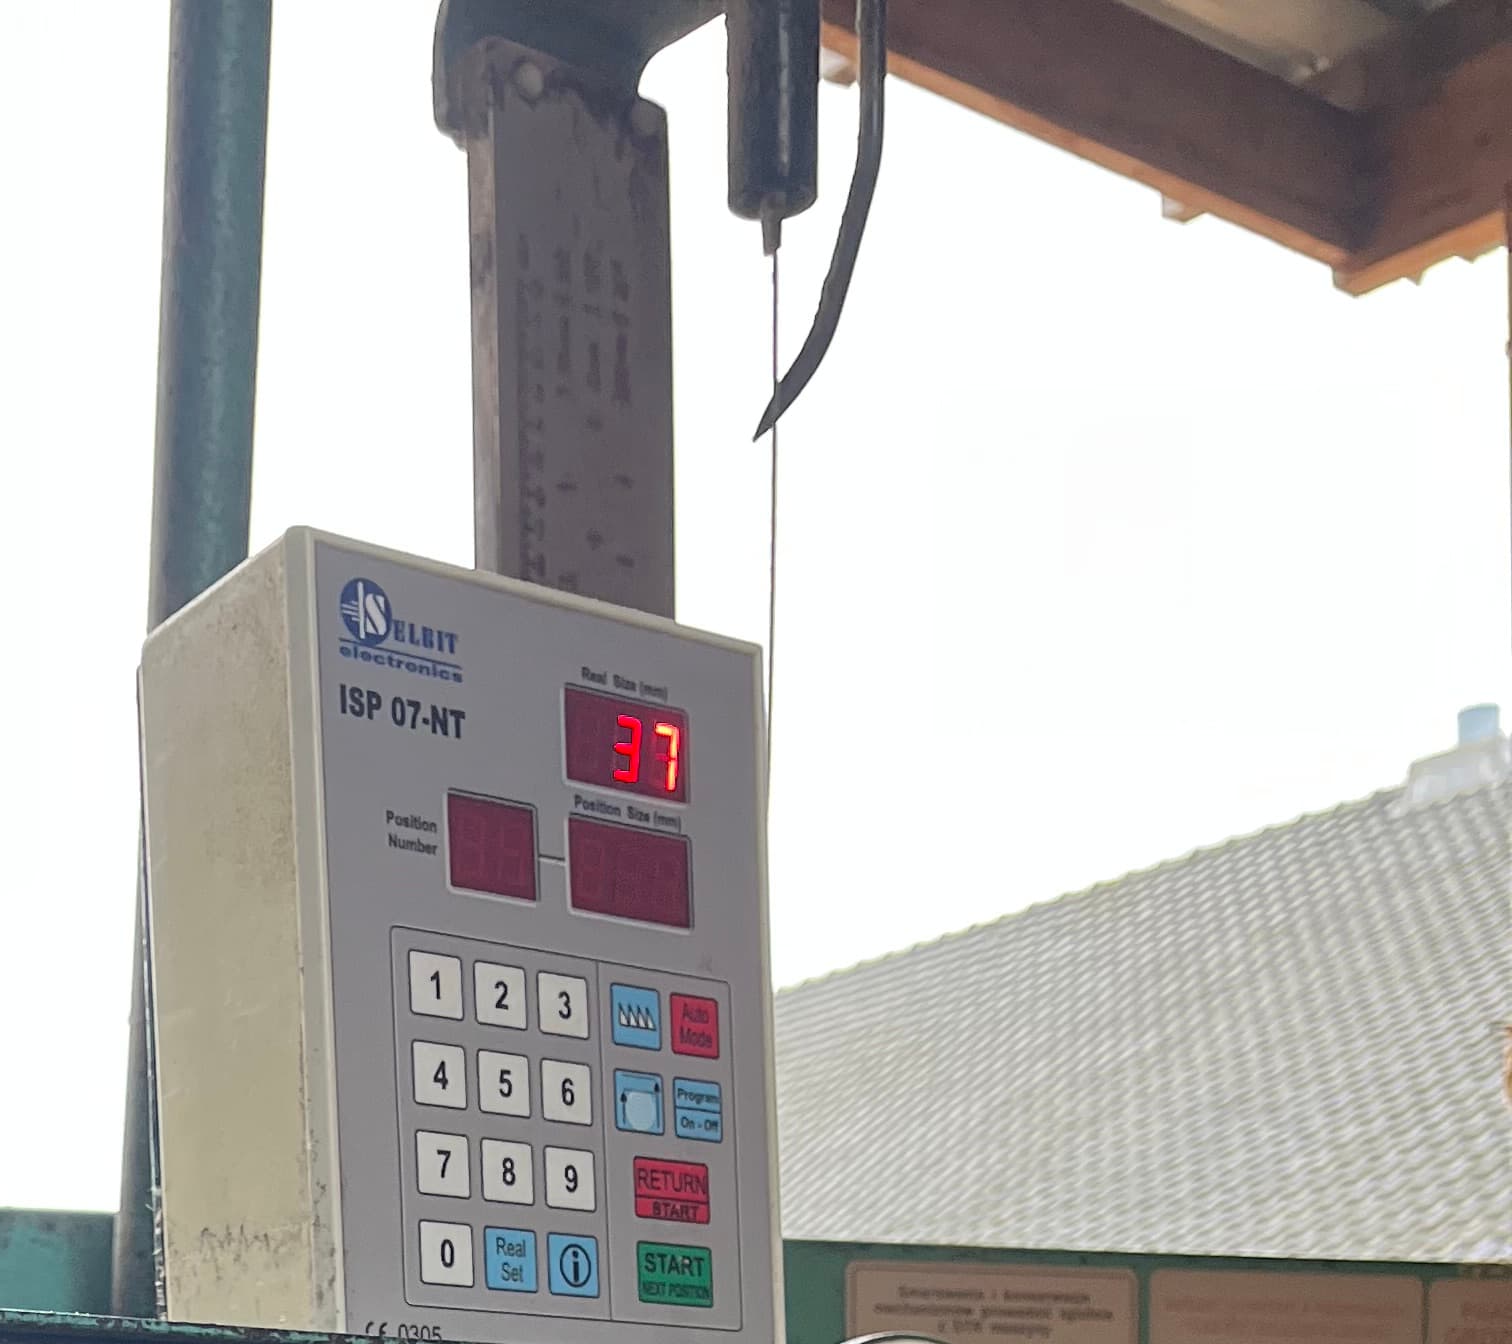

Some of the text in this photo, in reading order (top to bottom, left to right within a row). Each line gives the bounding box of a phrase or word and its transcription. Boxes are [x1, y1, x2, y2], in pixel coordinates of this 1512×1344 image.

[339, 645, 463, 683] electronics
[582, 666, 607, 685] Real
[613, 674, 636, 690] Size
[339, 683, 466, 739] ISP 07-NT
[613, 714, 680, 793] 37
[386, 809, 437, 833] Position
[574, 795, 681, 832] Position Size (mm)
[389, 833, 438, 856] Number
[431, 971, 441, 999] 1
[495, 981, 509, 1010] 2
[558, 992, 571, 1020] 3
[682, 1003, 709, 1024] Auto
[680, 1026, 713, 1048] Mode
[434, 1060, 448, 1090] 4
[499, 1069, 513, 1098] 5
[561, 1078, 574, 1106] 6
[681, 1117, 695, 1129] On
[704, 1119, 719, 1132] Off
[437, 1149, 451, 1178] 7
[502, 1158, 516, 1186] 8
[564, 1165, 578, 1193] 9
[637, 1168, 706, 1194] RETURN
[653, 1201, 699, 1219] START
[440, 1239, 455, 1268] 0
[496, 1237, 526, 1258] Real
[501, 1262, 524, 1284] Set
[644, 1253, 704, 1277] START
